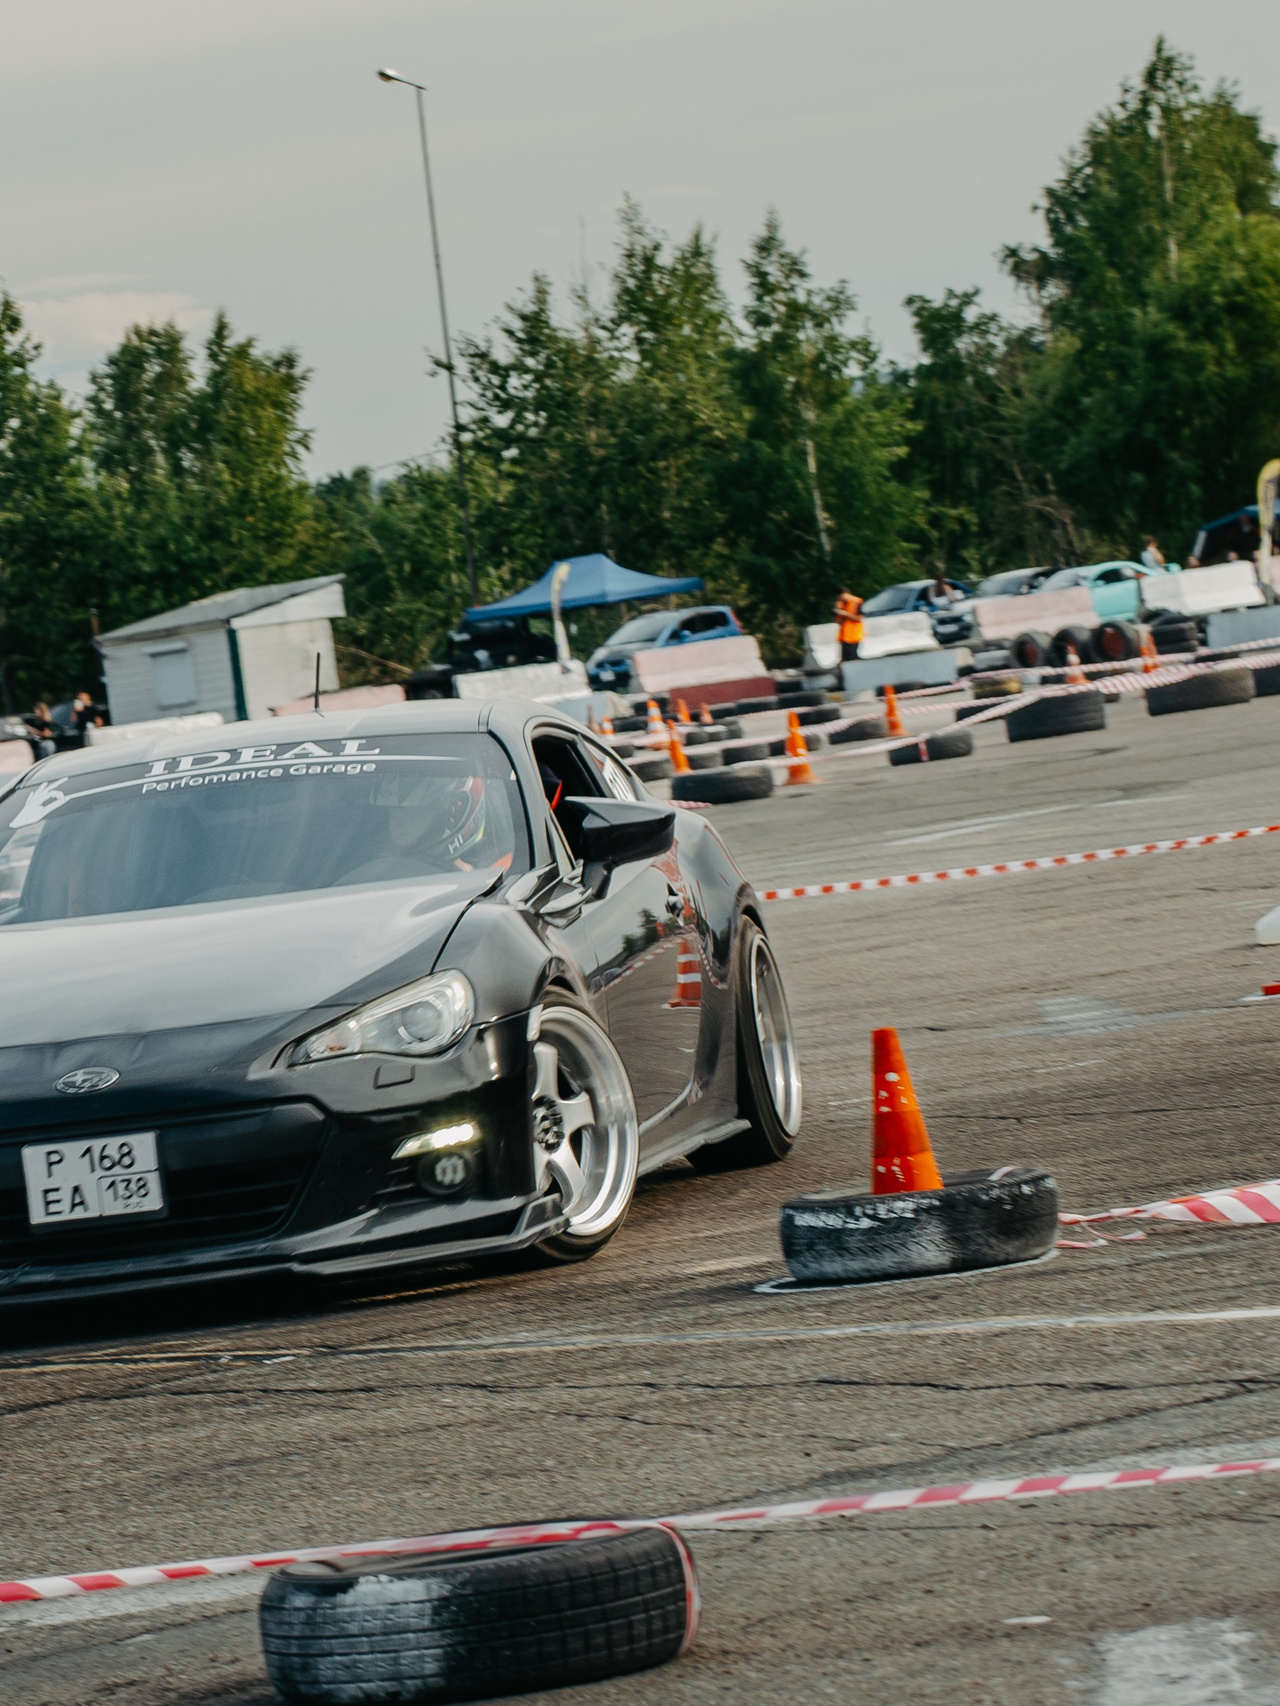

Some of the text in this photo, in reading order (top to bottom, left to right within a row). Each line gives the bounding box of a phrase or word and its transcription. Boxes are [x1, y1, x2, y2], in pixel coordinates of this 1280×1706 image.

[144, 739, 381, 777] IDEAL
[141, 762, 377, 794] Perfomance Garage
[79, 1141, 136, 1174] 168
[105, 1176, 150, 1201] 138
